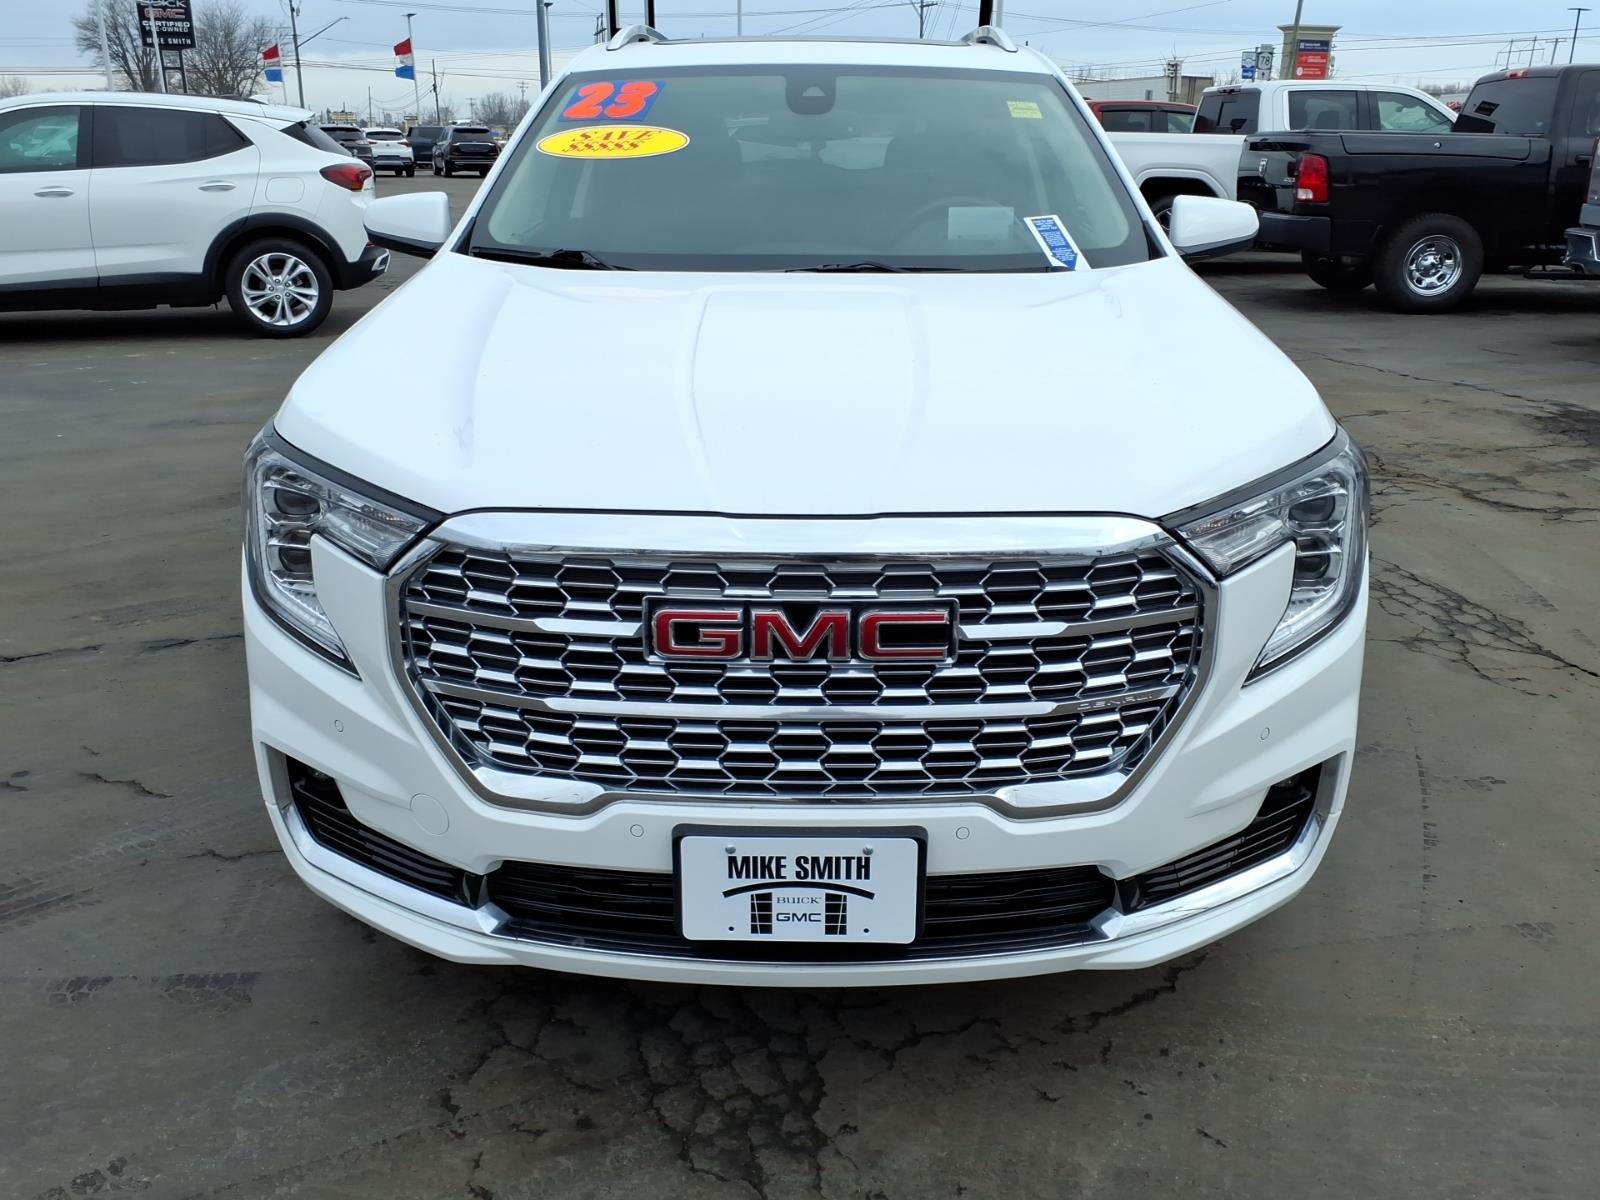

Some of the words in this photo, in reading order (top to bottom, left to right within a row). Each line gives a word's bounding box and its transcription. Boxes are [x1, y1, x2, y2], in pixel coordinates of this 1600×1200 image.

[146, 37, 165, 45] ME
[1260, 55, 1270, 66] 78
[563, 82, 657, 119] 23
[573, 130, 662, 142] SAVE
[652, 608, 949, 660] GMC
[728, 856, 787, 879] MIKE
[795, 856, 871, 880] SMITH
[776, 912, 822, 922] GMC
